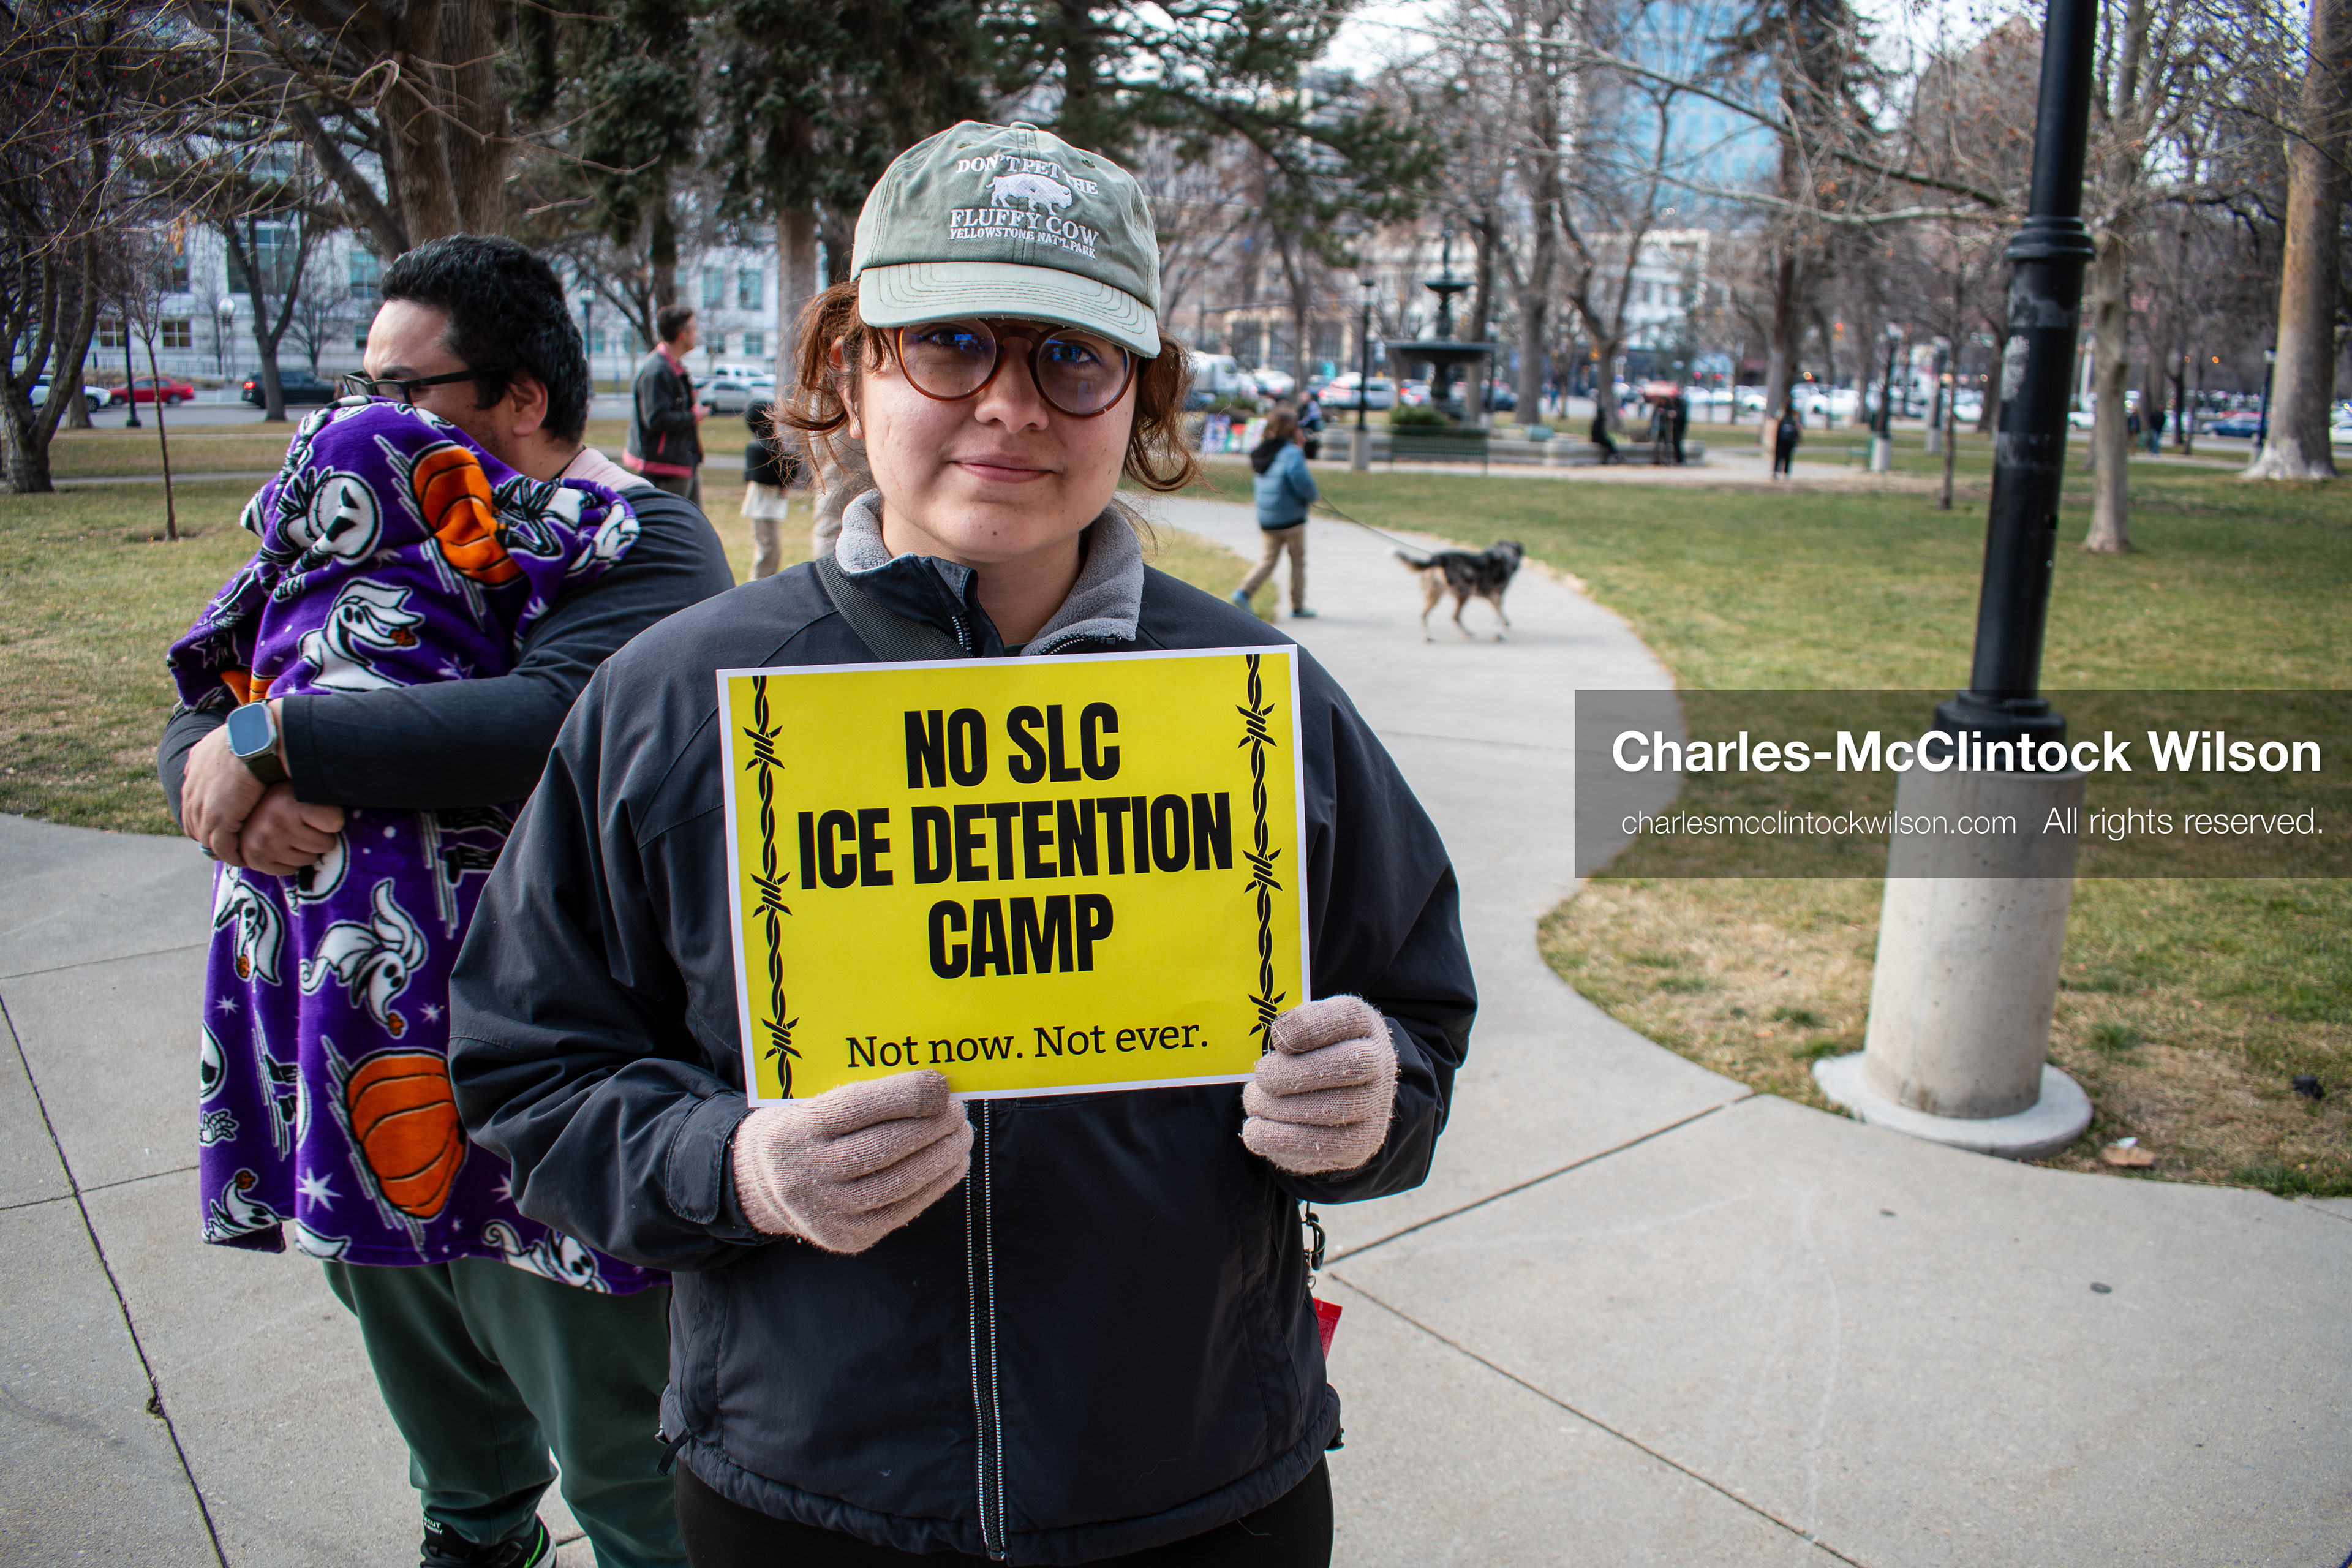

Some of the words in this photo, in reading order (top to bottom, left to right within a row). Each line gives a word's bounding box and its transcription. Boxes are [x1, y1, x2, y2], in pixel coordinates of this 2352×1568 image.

[956, 154, 1020, 173] DON'T
[1022, 158, 1061, 178] PET
[1061, 168, 1098, 195] THE
[948, 227, 1035, 240] YELLOWSTONE
[1069, 239, 1096, 260] PARK
[950, 208, 1042, 229] FLUFFY
[1046, 216, 1099, 247] COW
[904, 708, 987, 789] NO
[1006, 702, 1120, 784] SLC
[797, 807, 894, 890] ICE
[911, 791, 1234, 884] DETENTION
[928, 894, 1114, 979] CAMP
[845, 1036, 919, 1068] Not
[928, 1036, 1023, 1064] now.
[1033, 1025, 1106, 1058] Not
[1115, 1025, 1208, 1052] ever.
